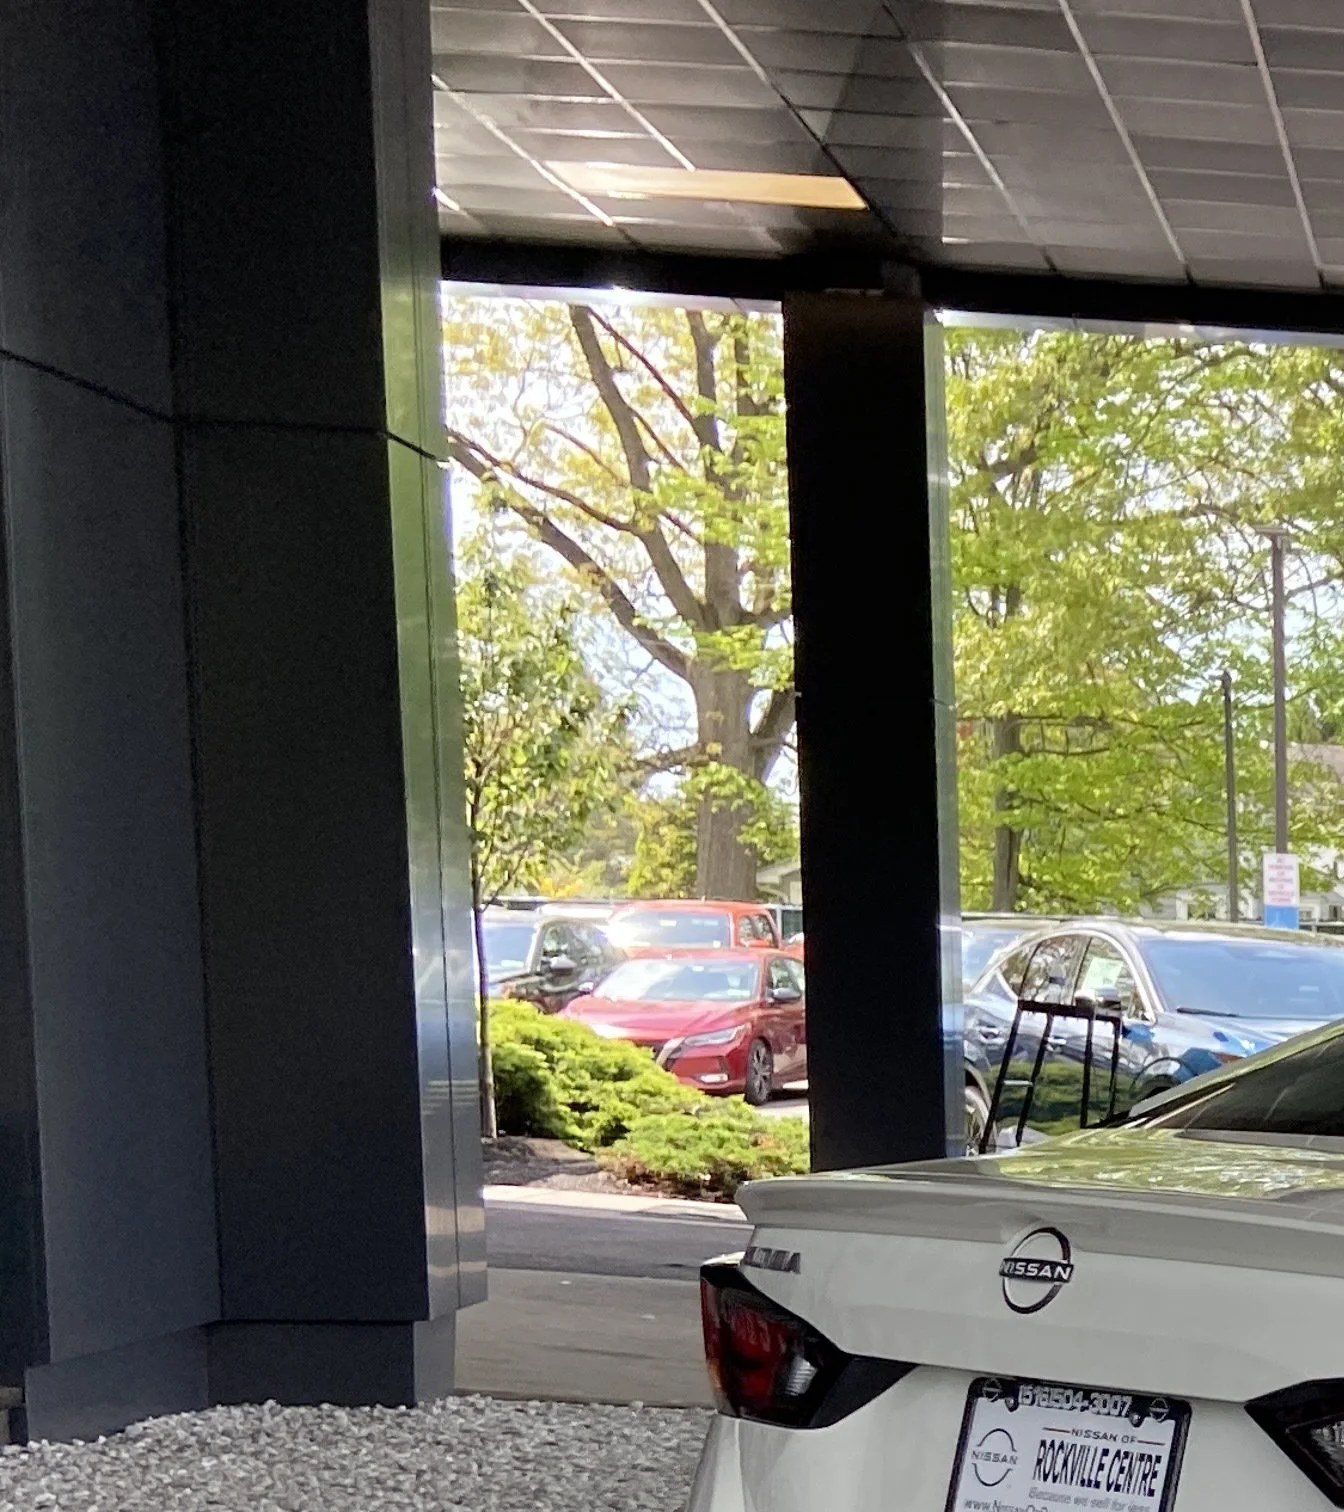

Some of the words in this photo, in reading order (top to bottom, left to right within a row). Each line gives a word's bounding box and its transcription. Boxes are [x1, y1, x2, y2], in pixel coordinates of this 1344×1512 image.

[1001, 1261, 1071, 1280] NISSAN
[1071, 1428, 1118, 1442] NISSAN
[1121, 1434, 1137, 1444] OF
[970, 1450, 1018, 1465] NISSAN
[1032, 1439, 1110, 1489] ROCKVILLE
[1106, 1448, 1162, 1497] CENTRE
